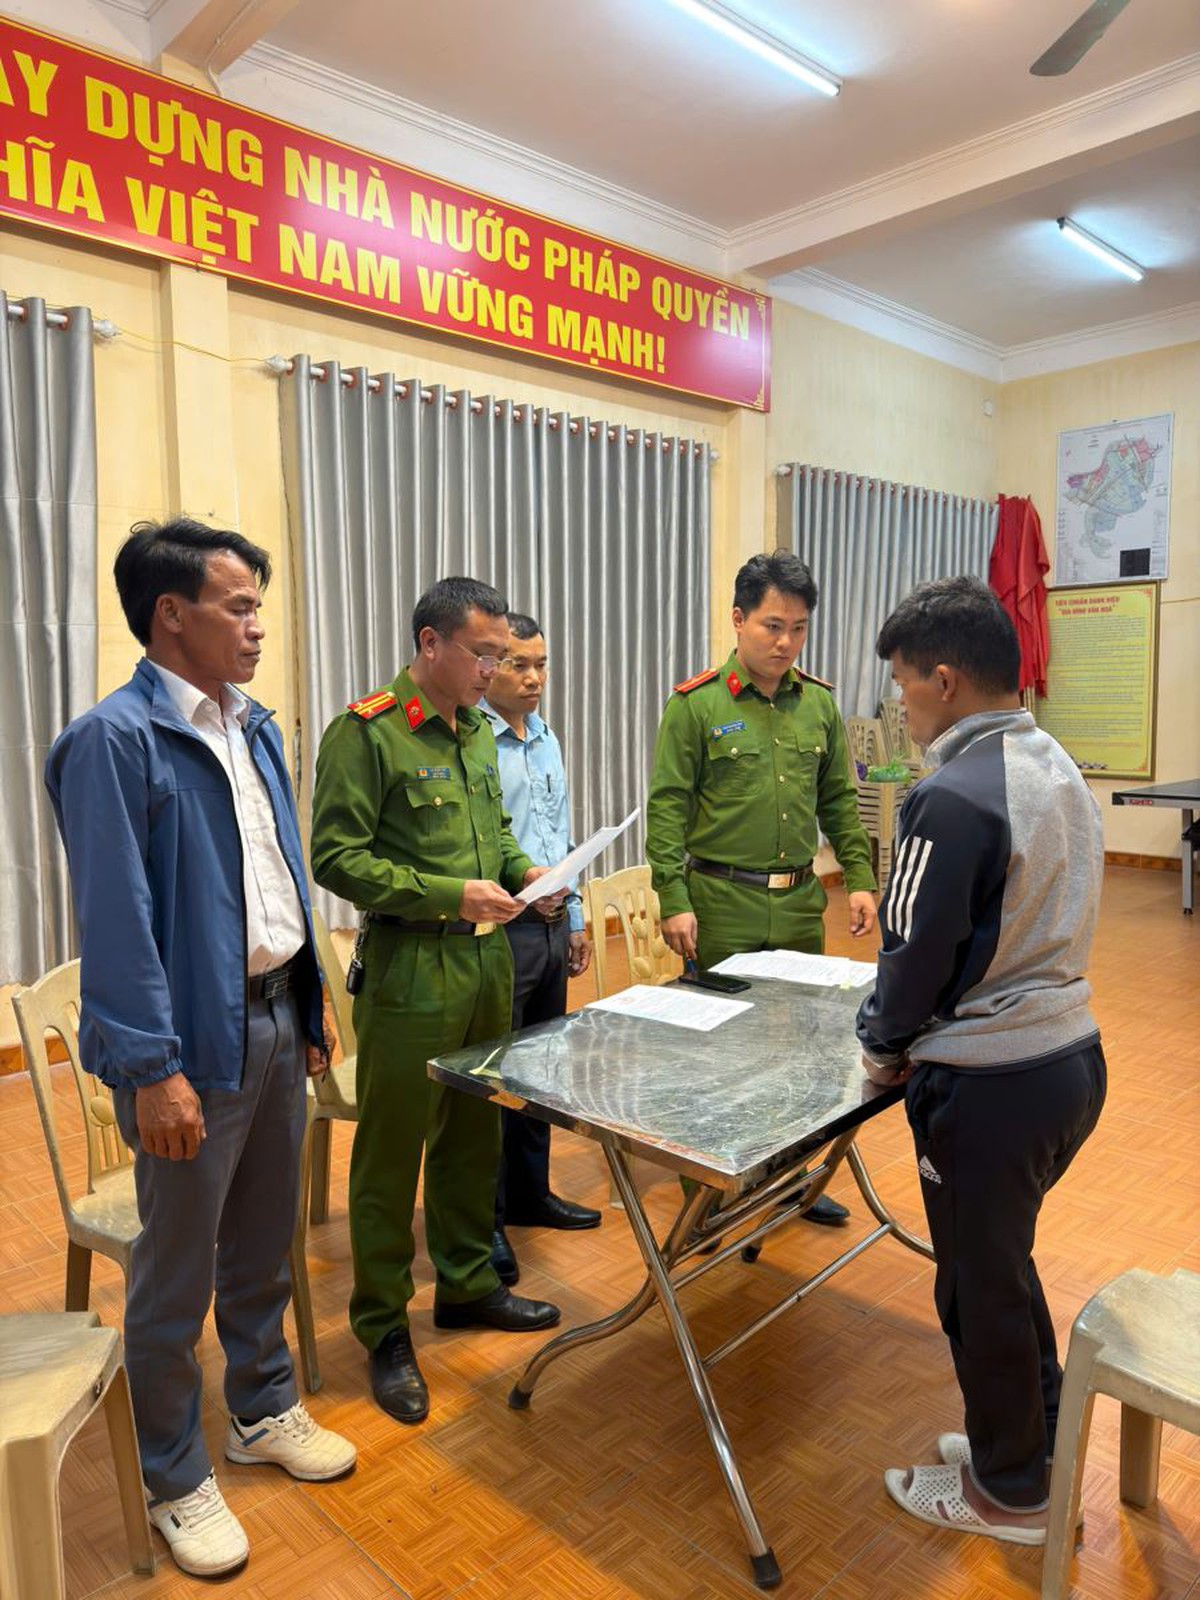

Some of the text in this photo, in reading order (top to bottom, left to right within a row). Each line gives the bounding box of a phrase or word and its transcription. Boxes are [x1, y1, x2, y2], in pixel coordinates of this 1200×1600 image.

[85, 75, 264, 187] DỰNG
[284, 145, 395, 230] NHÀ
[410, 191, 530, 271] NƯỚC
[544, 237, 641, 303] PHÁP
[652, 276, 749, 341] QUYỀN
[125, 176, 259, 265] VIỆT
[278, 223, 401, 305] NAM
[417, 266, 534, 340] VỮNG
[547, 304, 666, 374] MẠNH!
